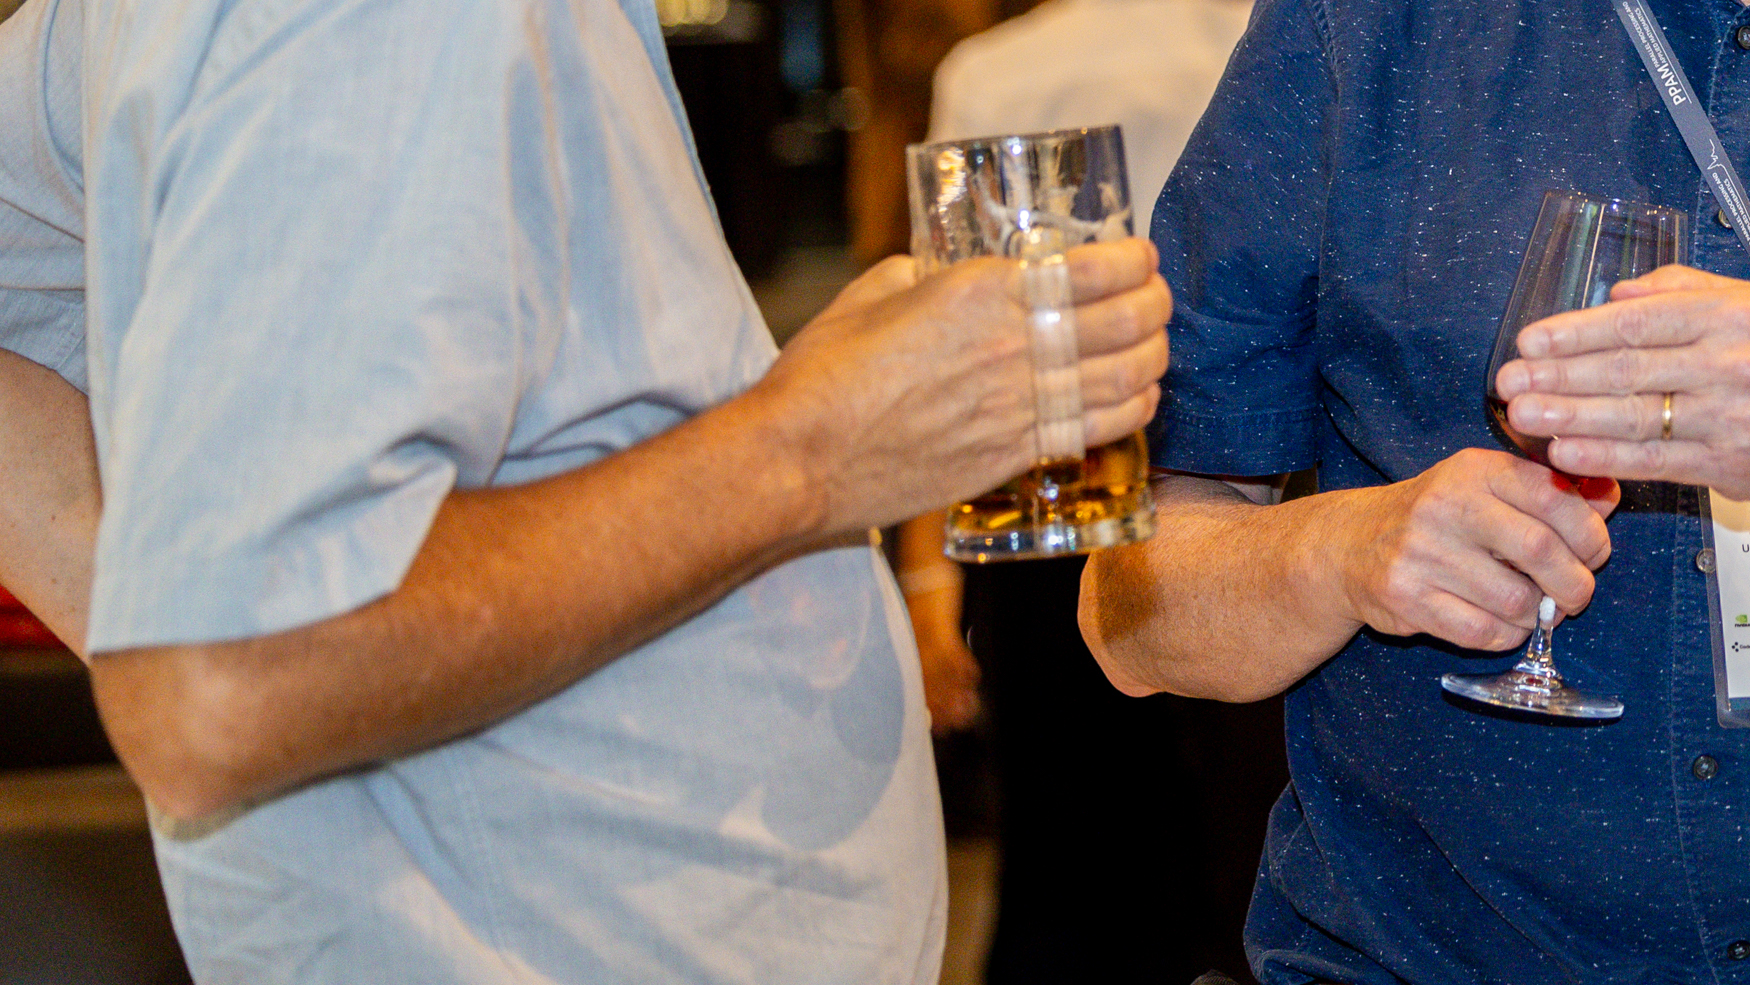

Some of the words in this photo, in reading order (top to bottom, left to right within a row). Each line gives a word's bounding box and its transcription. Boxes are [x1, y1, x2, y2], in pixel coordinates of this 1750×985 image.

[1622, 1, 1631, 13] AND
[1627, 11, 1647, 43] PROCESSING
[1634, 7, 1656, 43] MATHEMATICS
[1644, 43, 1660, 68] PARALLEL
[1652, 42, 1667, 64] APPLIED
[1657, 63, 1687, 106] PPAM
[1712, 172, 1722, 184] AND
[1718, 183, 1738, 216] PROCESSING
[1736, 215, 1750, 241] PARALLEL
